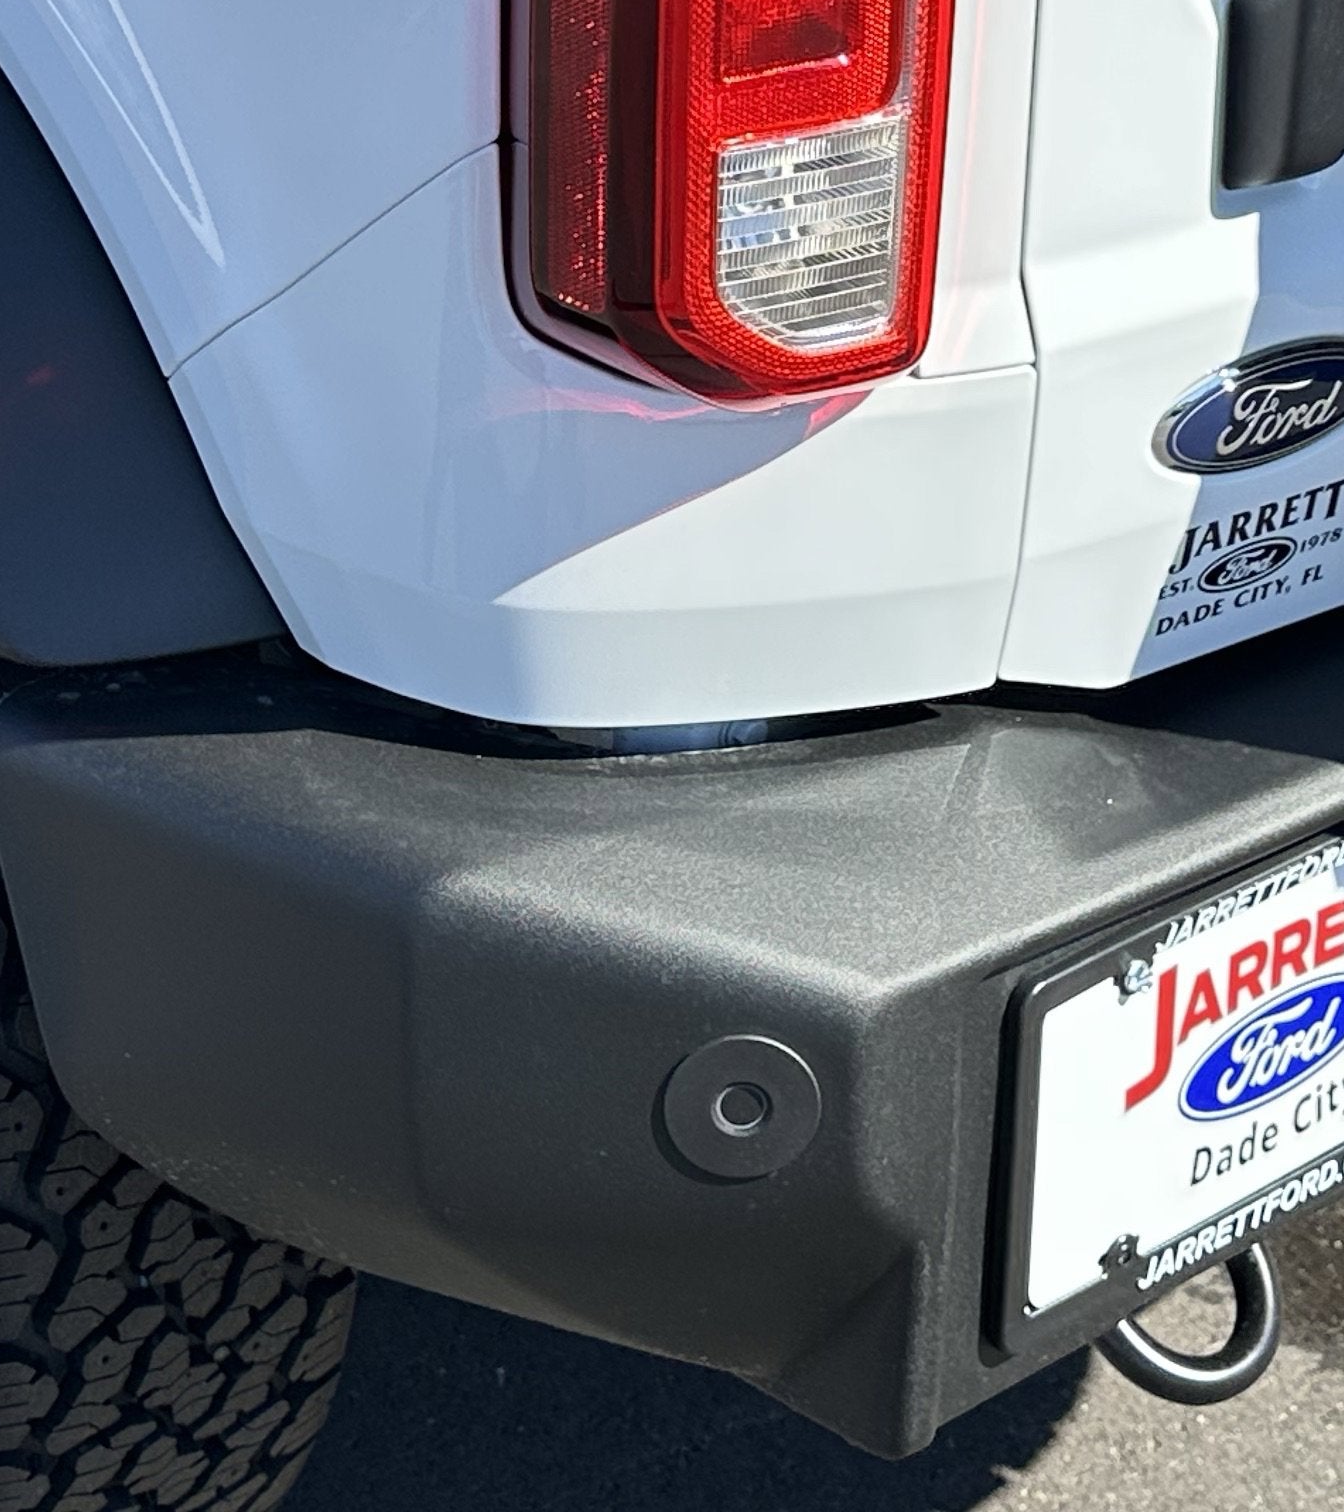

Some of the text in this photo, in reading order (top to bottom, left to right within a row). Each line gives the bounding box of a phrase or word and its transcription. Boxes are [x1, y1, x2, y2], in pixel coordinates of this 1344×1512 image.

[1216, 378, 1344, 456] Ford
[1155, 563, 1324, 636] DADE CITY, FL
[1158, 527, 1344, 601] EST. Ford 1978
[1215, 995, 1343, 1104] Ford
[1188, 1121, 1279, 1188] Dade
